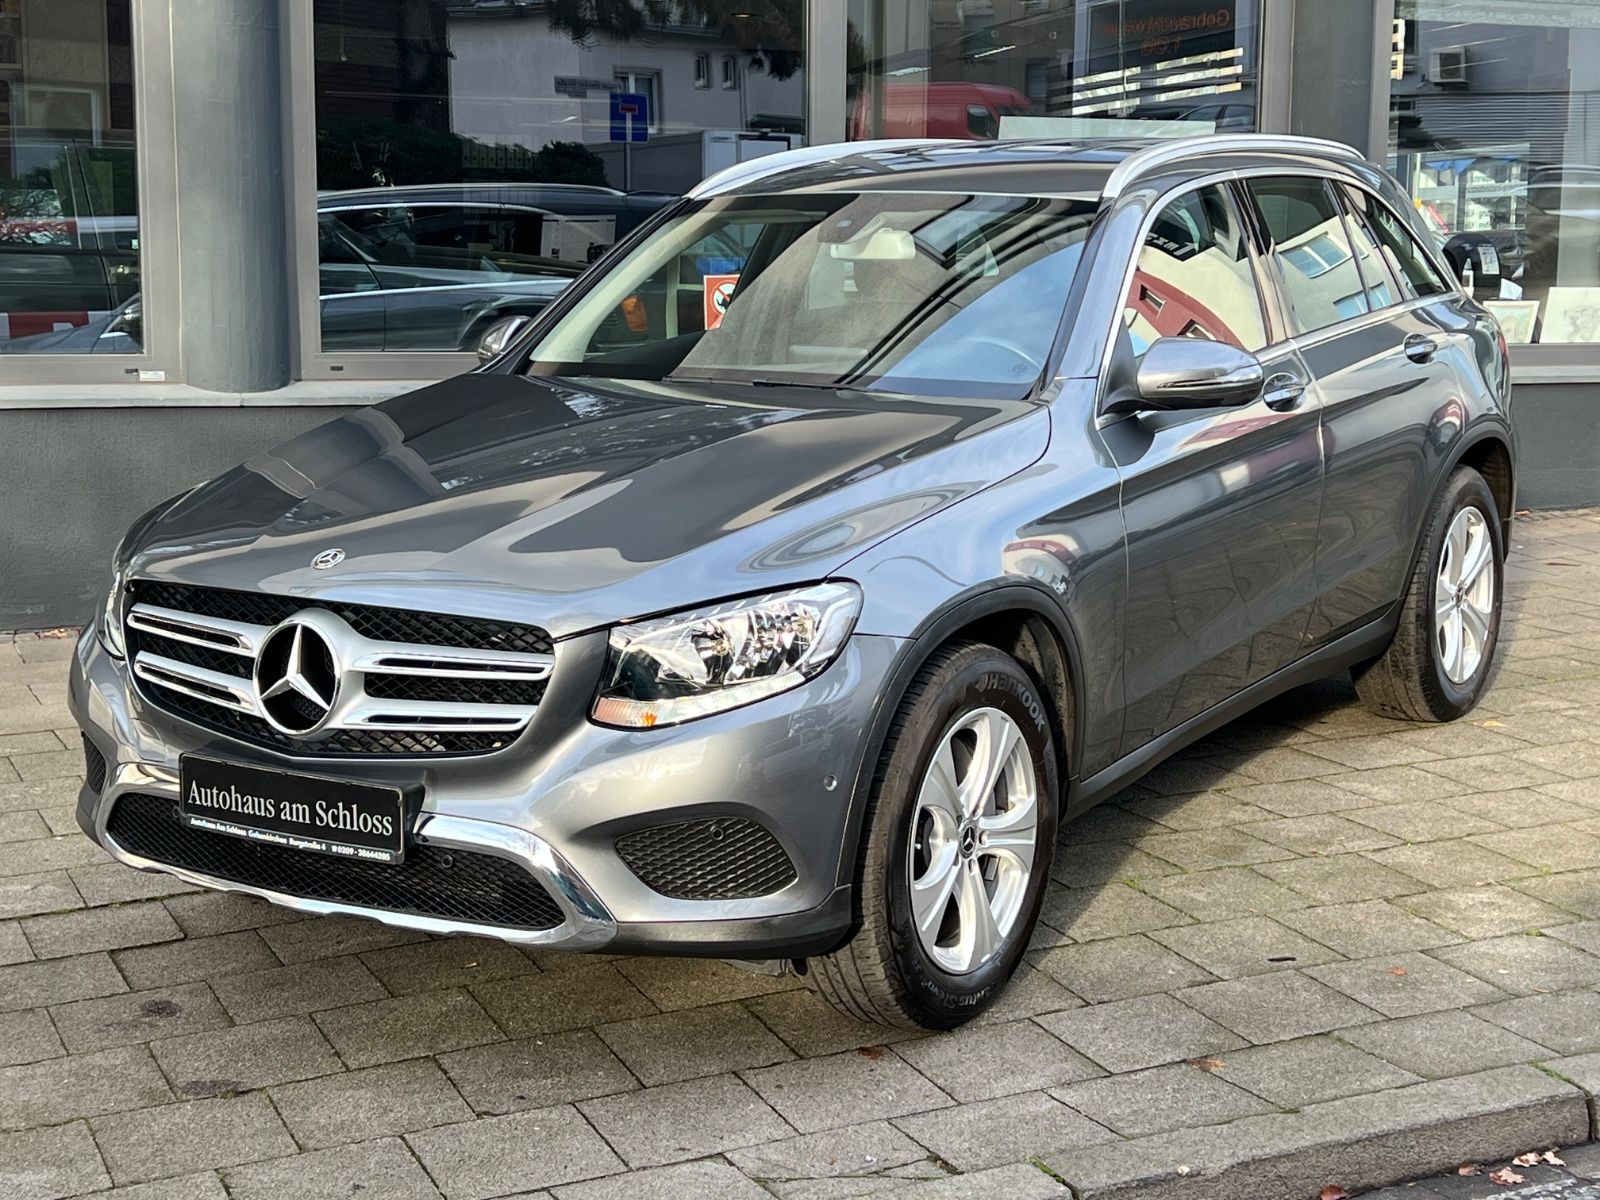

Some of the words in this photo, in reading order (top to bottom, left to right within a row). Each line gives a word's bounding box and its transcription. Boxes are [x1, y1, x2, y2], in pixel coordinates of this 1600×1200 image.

[187, 779, 275, 818] Autohaus
[280, 801, 311, 823] am
[315, 800, 393, 836] Schloss
